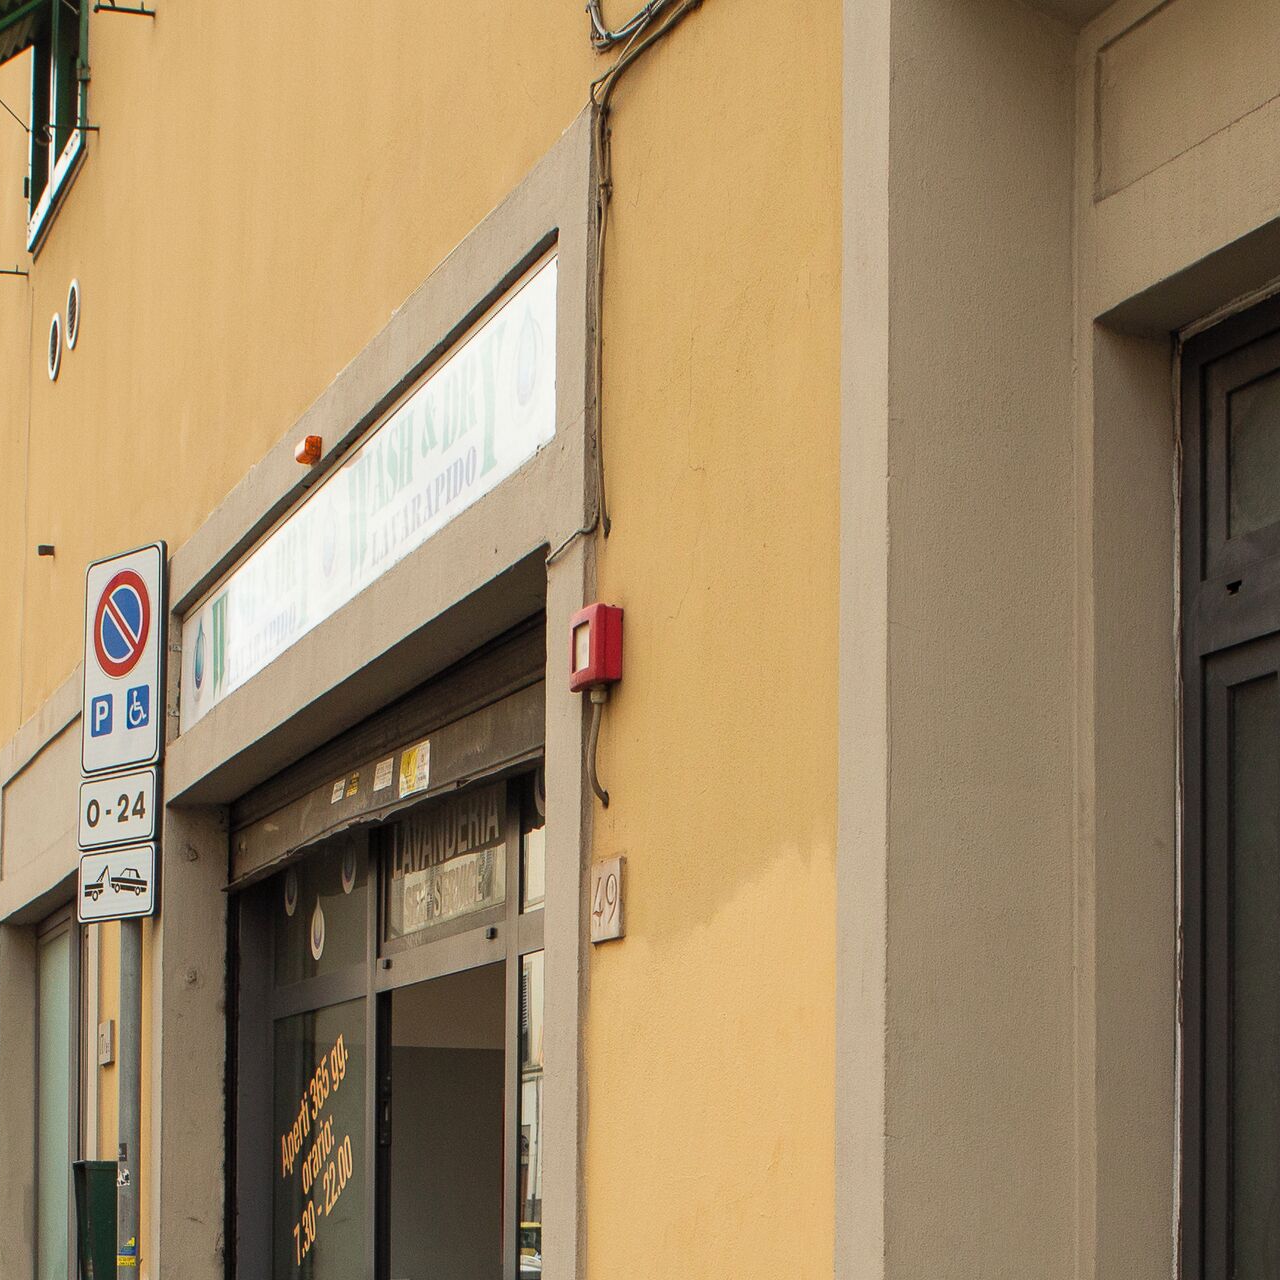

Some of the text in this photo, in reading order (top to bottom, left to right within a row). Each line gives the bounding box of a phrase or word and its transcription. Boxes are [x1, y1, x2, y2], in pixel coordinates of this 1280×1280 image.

[94, 701, 109, 732] P
[87, 797, 100, 828] 0
[117, 790, 147, 824] 24
[393, 797, 500, 880] LAVANDERIA
[592, 873, 618, 927] 49
[281, 1033, 349, 1178] Aperti 365 gg.
[302, 1114, 335, 1195] orario:
[293, 1200, 316, 1266] 7.30
[323, 1135, 353, 1217] 22.00
